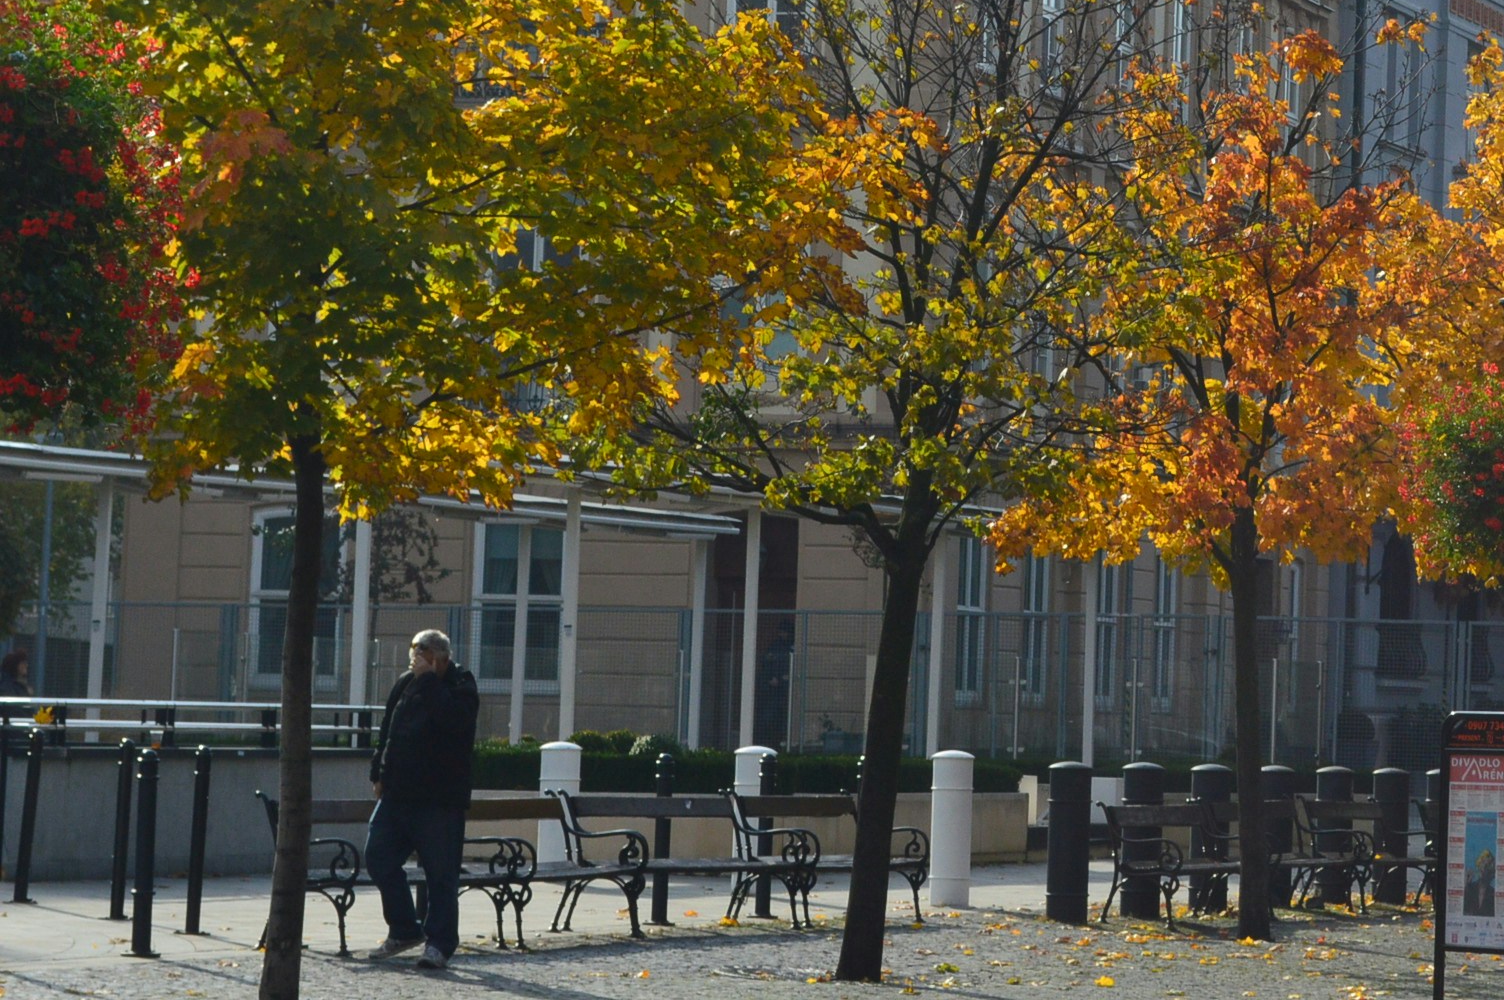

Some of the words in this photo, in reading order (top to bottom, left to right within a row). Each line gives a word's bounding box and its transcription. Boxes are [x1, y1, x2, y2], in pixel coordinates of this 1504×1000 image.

[1467, 720, 1488, 731] 0907
[1490, 721, 1504, 731] 734
[1451, 757, 1500, 769] DIVADLO
